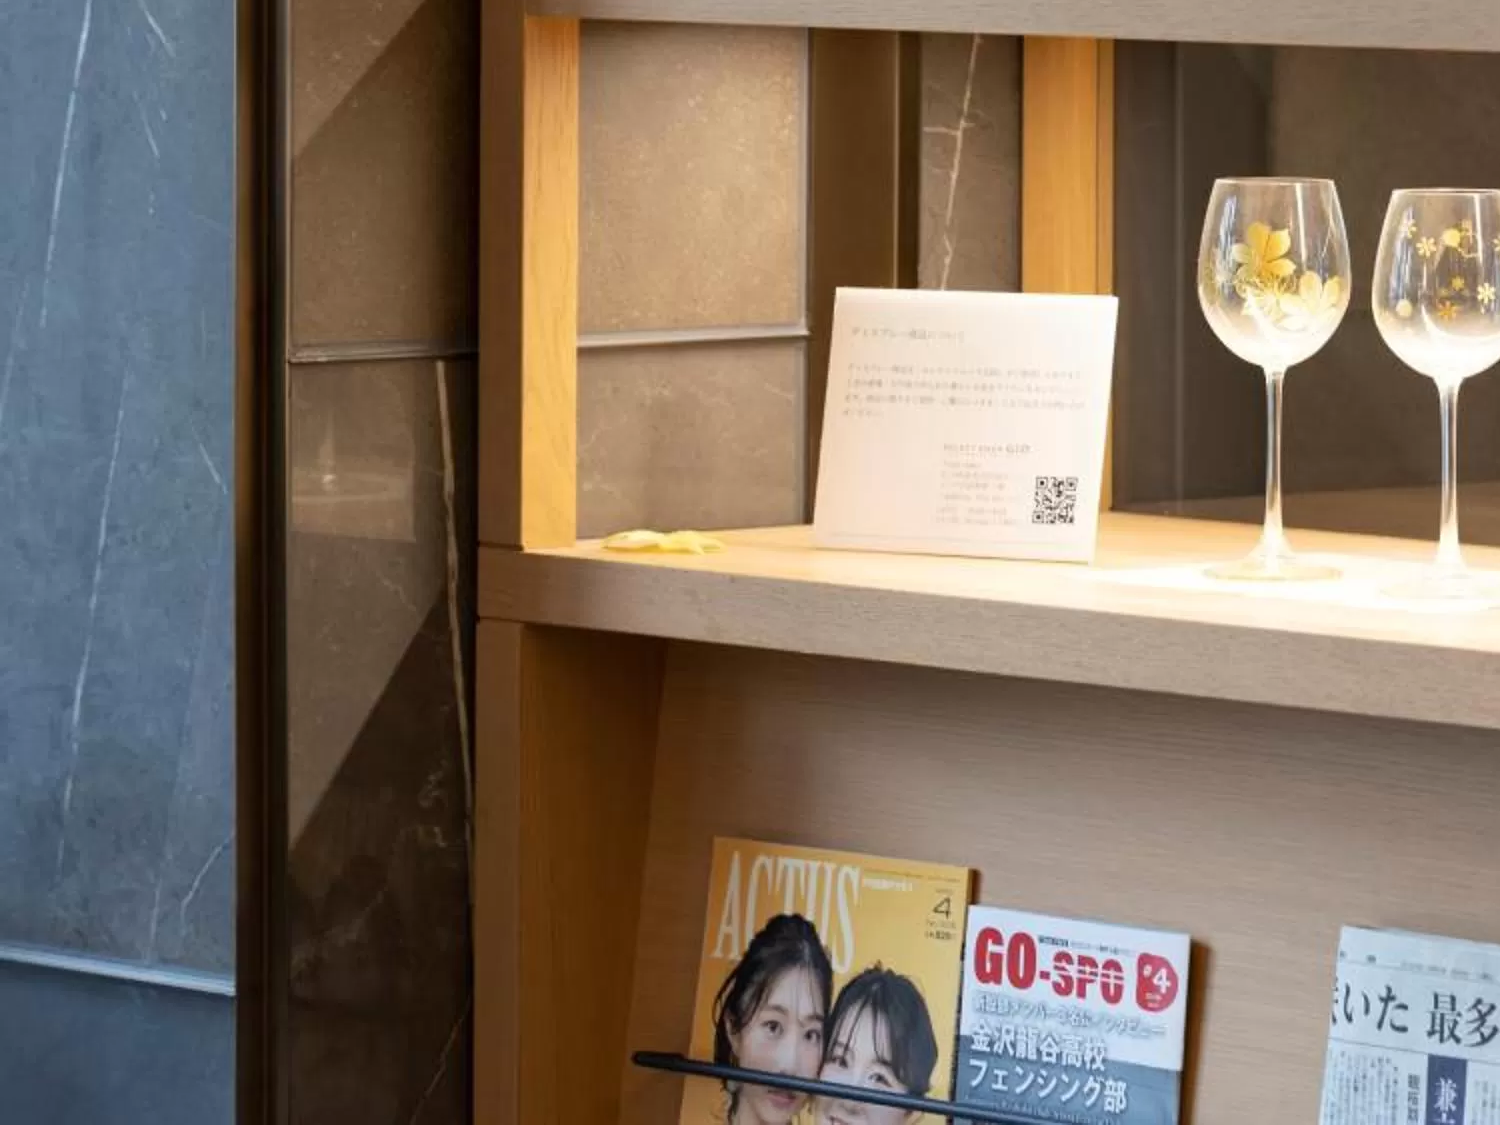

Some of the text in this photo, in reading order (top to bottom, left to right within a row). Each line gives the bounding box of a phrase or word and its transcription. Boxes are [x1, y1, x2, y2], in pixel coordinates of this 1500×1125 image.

[932, 896, 952, 920] 4
[974, 926, 1125, 1005] GO-SPO
[1332, 978, 1409, 1034] いた
[1426, 991, 1500, 1048] 最多
[970, 1019, 1106, 1072] 金沢龍谷高校
[968, 1058, 1128, 1114] フェンシング部
